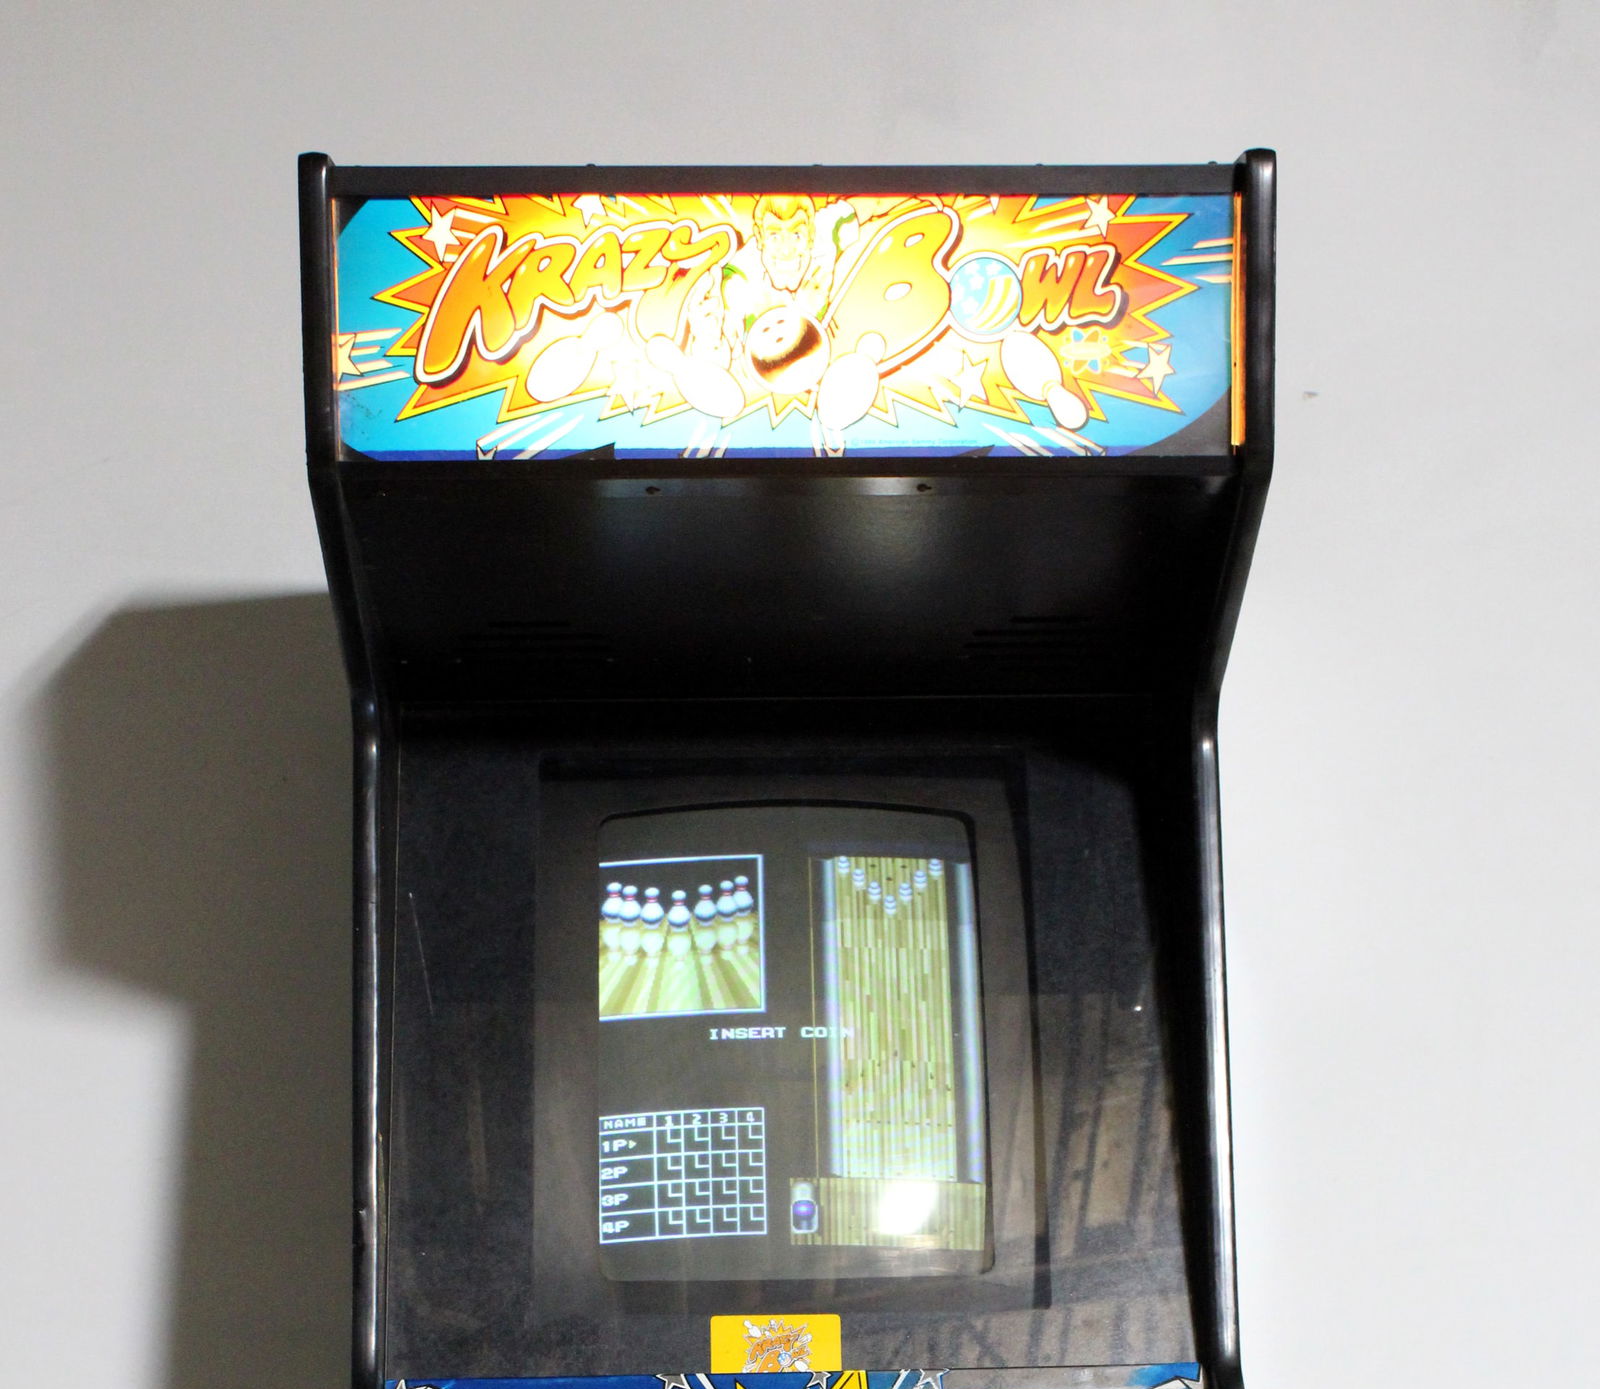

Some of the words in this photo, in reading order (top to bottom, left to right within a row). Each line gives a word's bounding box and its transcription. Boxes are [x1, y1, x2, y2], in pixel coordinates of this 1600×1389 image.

[415, 219, 738, 384] KRAZY
[709, 1026, 787, 1040] INSERT
[800, 1026, 855, 1039] COIN
[603, 1117, 647, 1130] NAME
[664, 1115, 674, 1127] 1
[692, 1113, 702, 1125] 2
[719, 1112, 729, 1124] 3
[746, 1111, 755, 1122] 4
[602, 1139, 627, 1152] 1P
[601, 1166, 628, 1180] 2P
[601, 1193, 629, 1207] 3P
[602, 1220, 630, 1234] 4P
